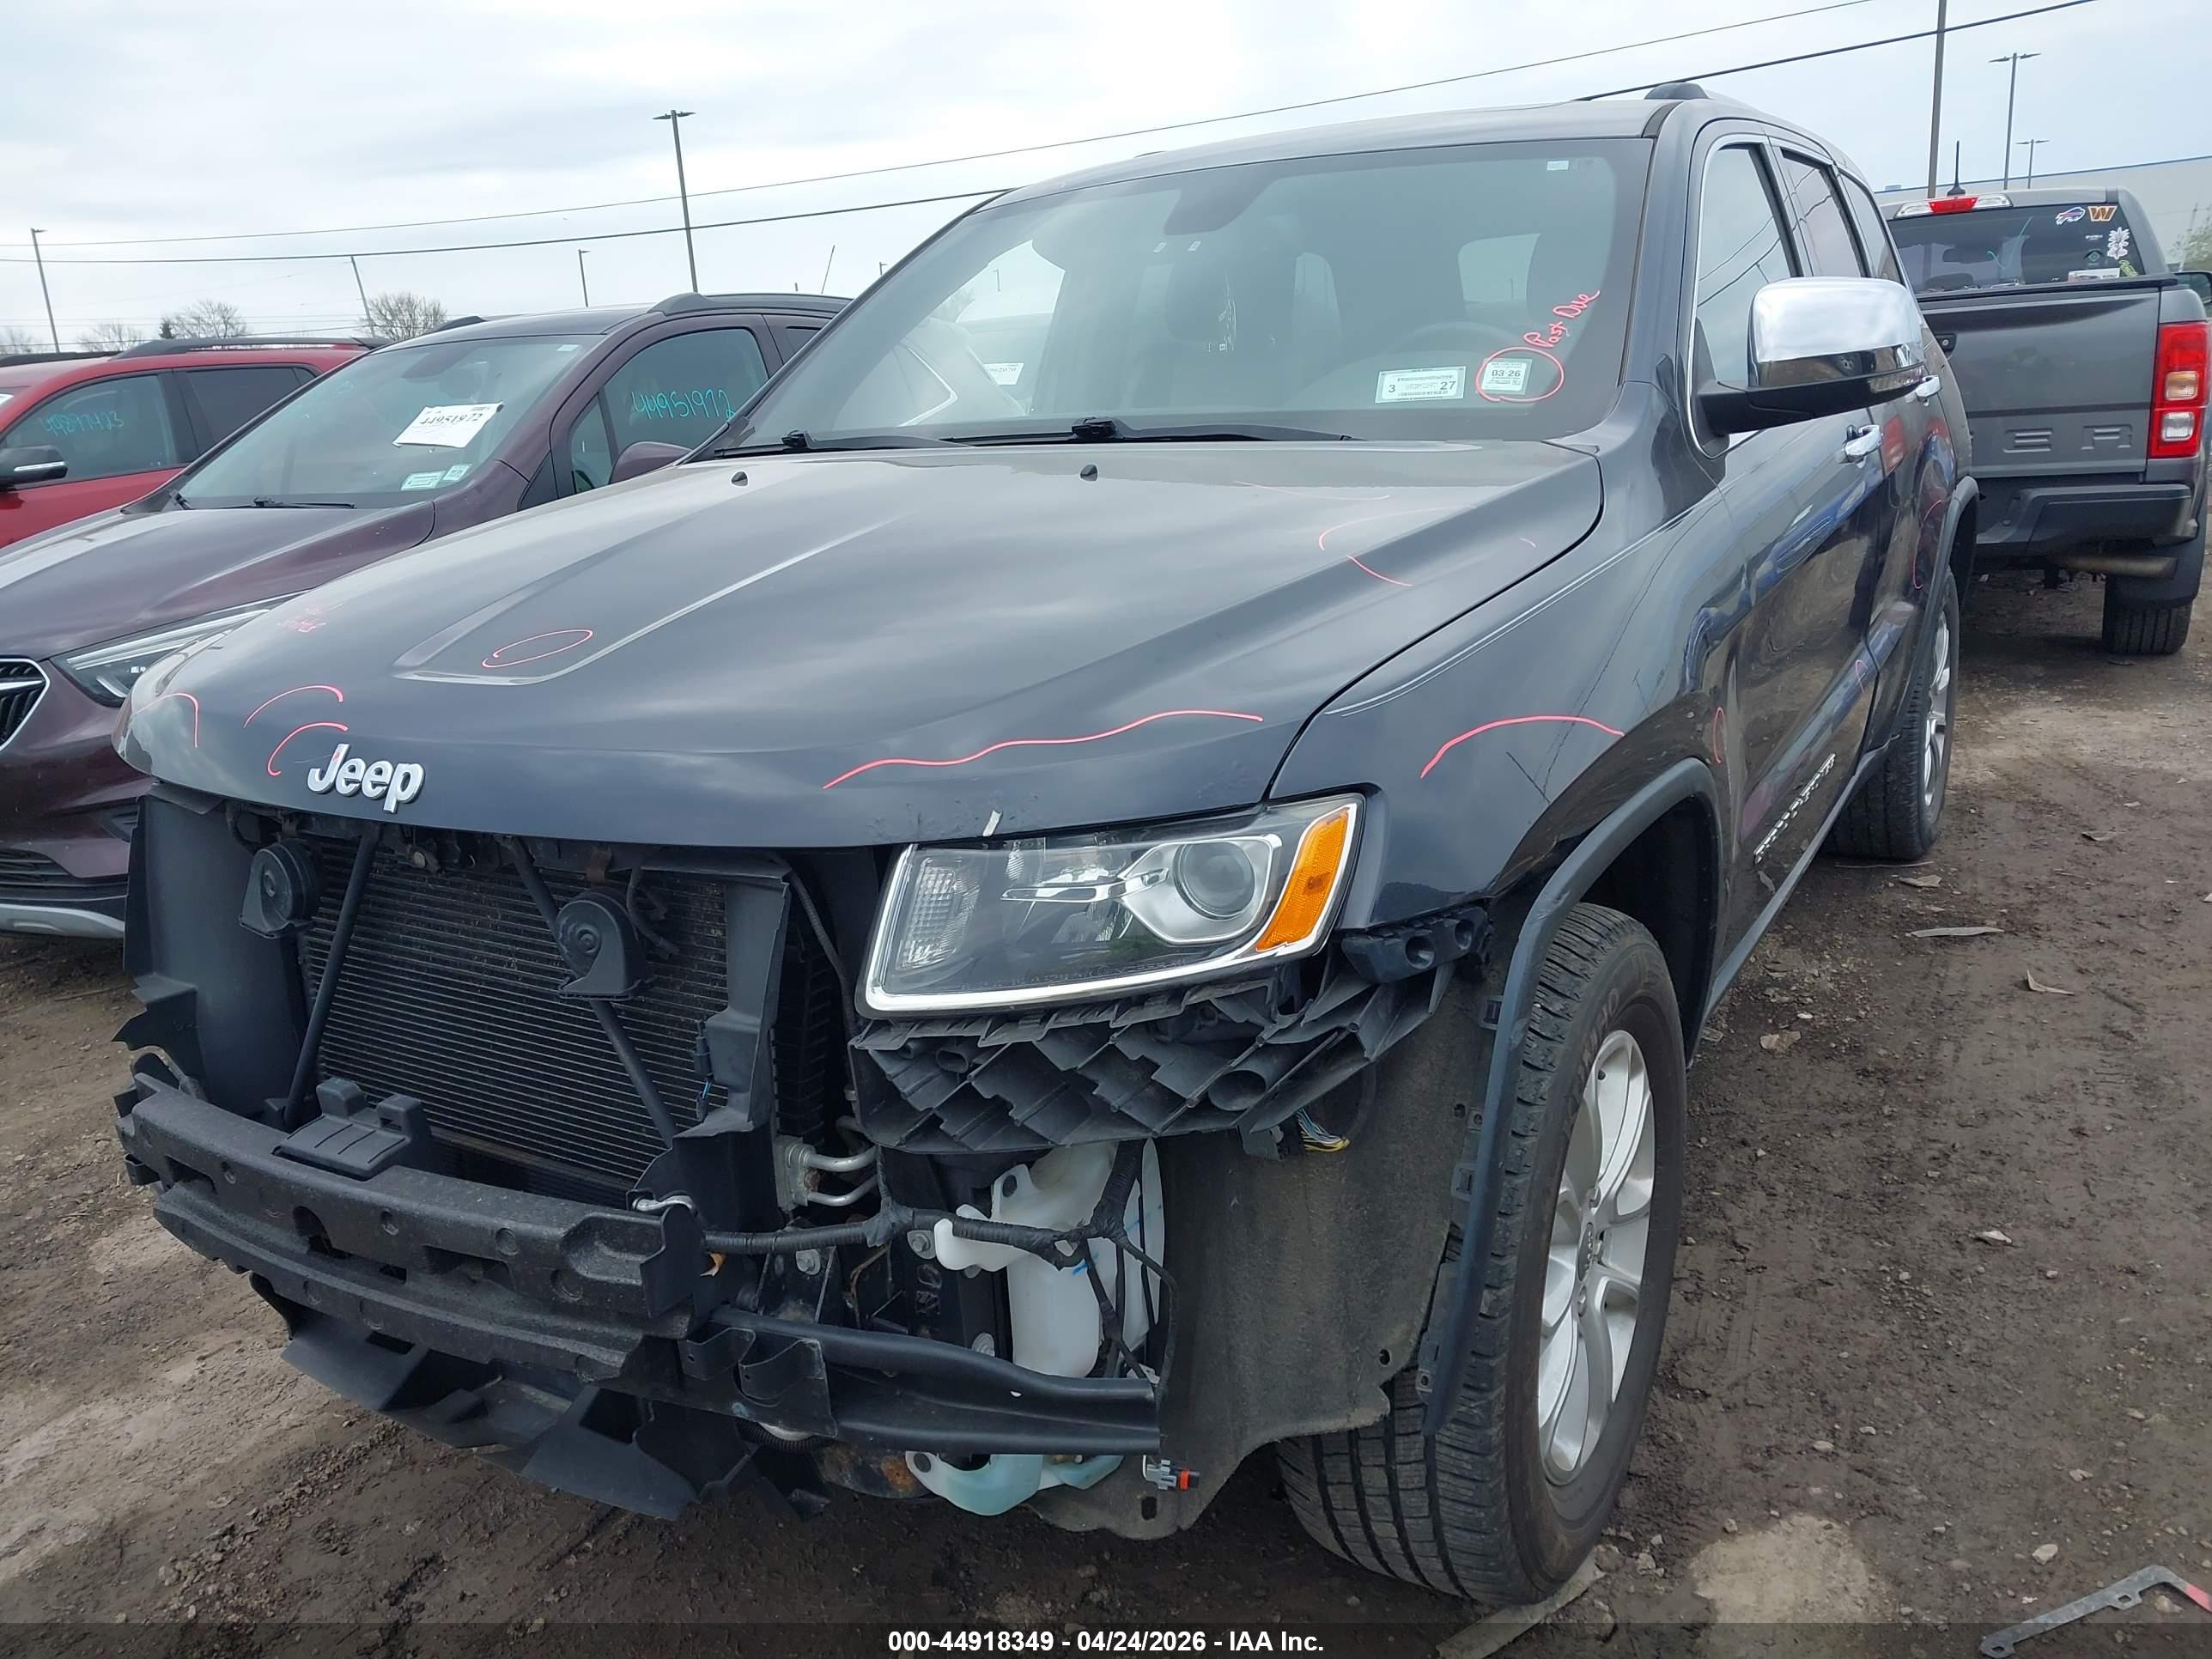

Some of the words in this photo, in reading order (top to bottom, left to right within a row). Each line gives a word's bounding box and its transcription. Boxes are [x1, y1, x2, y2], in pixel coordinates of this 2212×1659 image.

[1523, 321, 1571, 348] Past
[1553, 289, 1601, 319] Due
[1388, 384, 1396, 393] 3
[1439, 380, 1457, 391] 27
[630, 389, 736, 420] 44951972
[307, 743, 425, 814] Jeep
